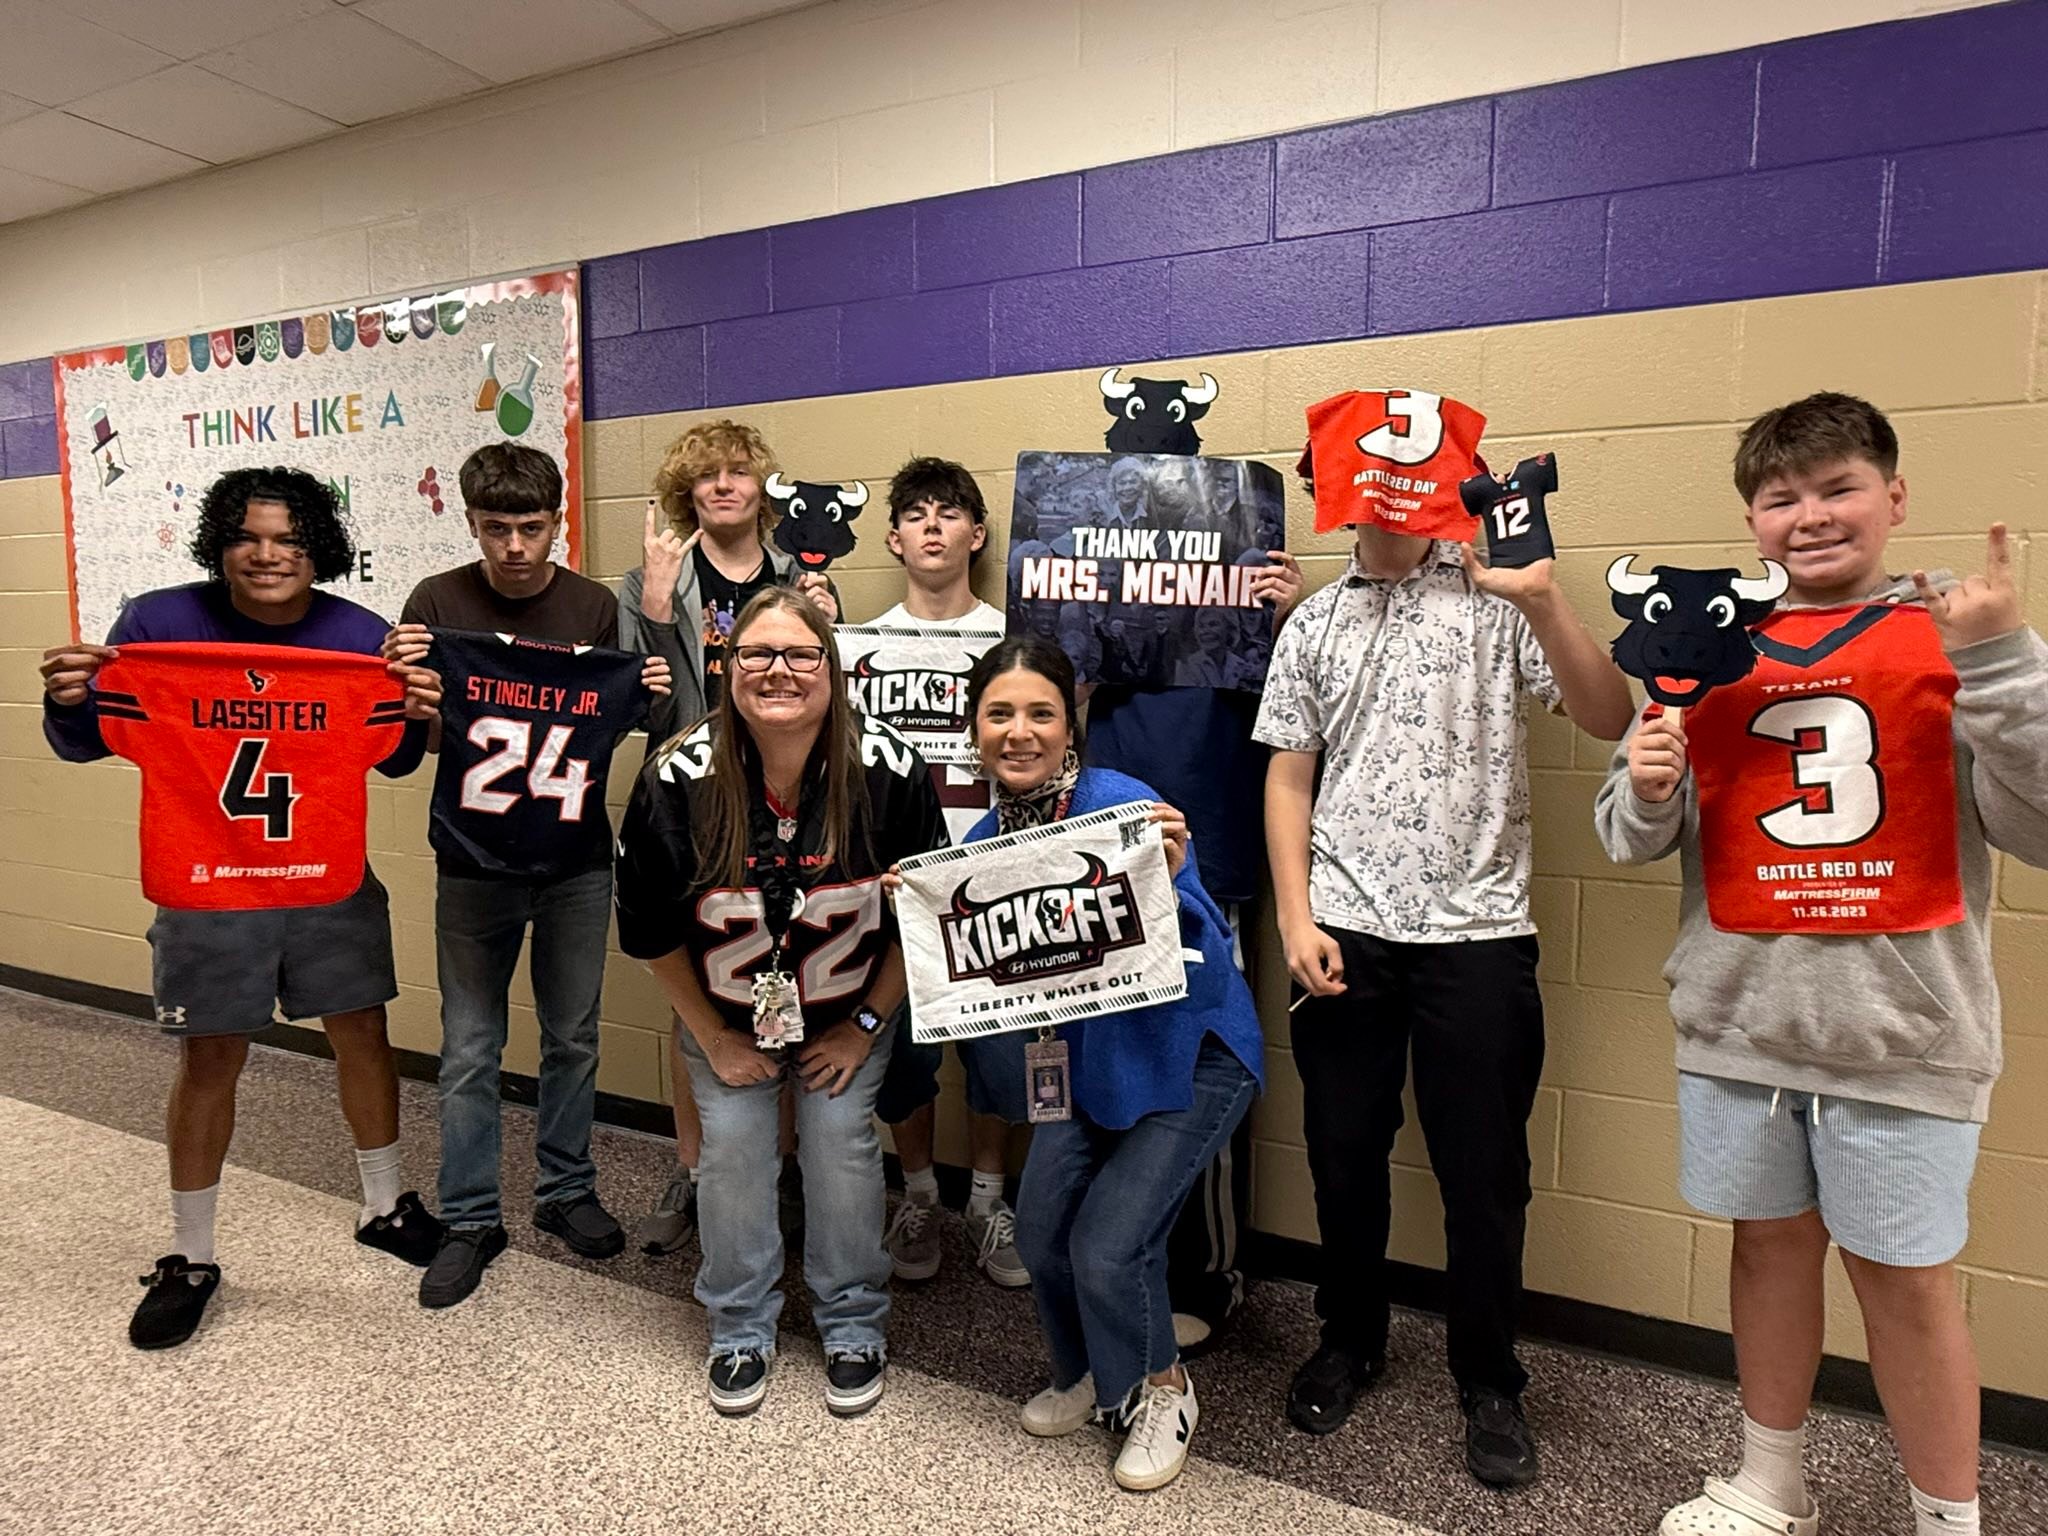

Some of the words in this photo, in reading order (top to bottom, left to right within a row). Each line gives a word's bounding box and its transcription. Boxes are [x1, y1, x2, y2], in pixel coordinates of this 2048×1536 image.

[182, 404, 277, 448] THINK
[293, 393, 364, 438] LIKE
[380, 389, 404, 429] A
[1413, 479, 1438, 495] DAY
[1491, 497, 1531, 540] 12
[1072, 526, 1162, 559] THANK
[1168, 530, 1222, 562] YOU
[1021, 557, 1109, 602] MRS.
[515, 639, 571, 654] HOUSTON
[466, 675, 567, 712] STINGLEY
[571, 691, 602, 717] JR.
[847, 671, 970, 717] KICKOF
[1759, 675, 1854, 695] TEXANS
[191, 697, 327, 731] LASSITER
[907, 717, 951, 727] HYUNDAI
[912, 740, 957, 750] WHITE
[219, 737, 303, 841] 4
[460, 715, 596, 822] 24
[1746, 692, 1887, 850] 3
[1756, 863, 1817, 881] BATTLE
[1822, 862, 1857, 878] RED
[1862, 860, 1896, 877] DAY
[946, 882, 1131, 975] KICKOFF
[1792, 905, 1868, 919] 11.26.2023
[697, 875, 884, 1007] 22
[1029, 951, 1081, 970] HYUNDAI
[960, 992, 1036, 1015] LIBERTY
[1044, 981, 1101, 1002] WHITE
[1107, 971, 1144, 988] OUT
